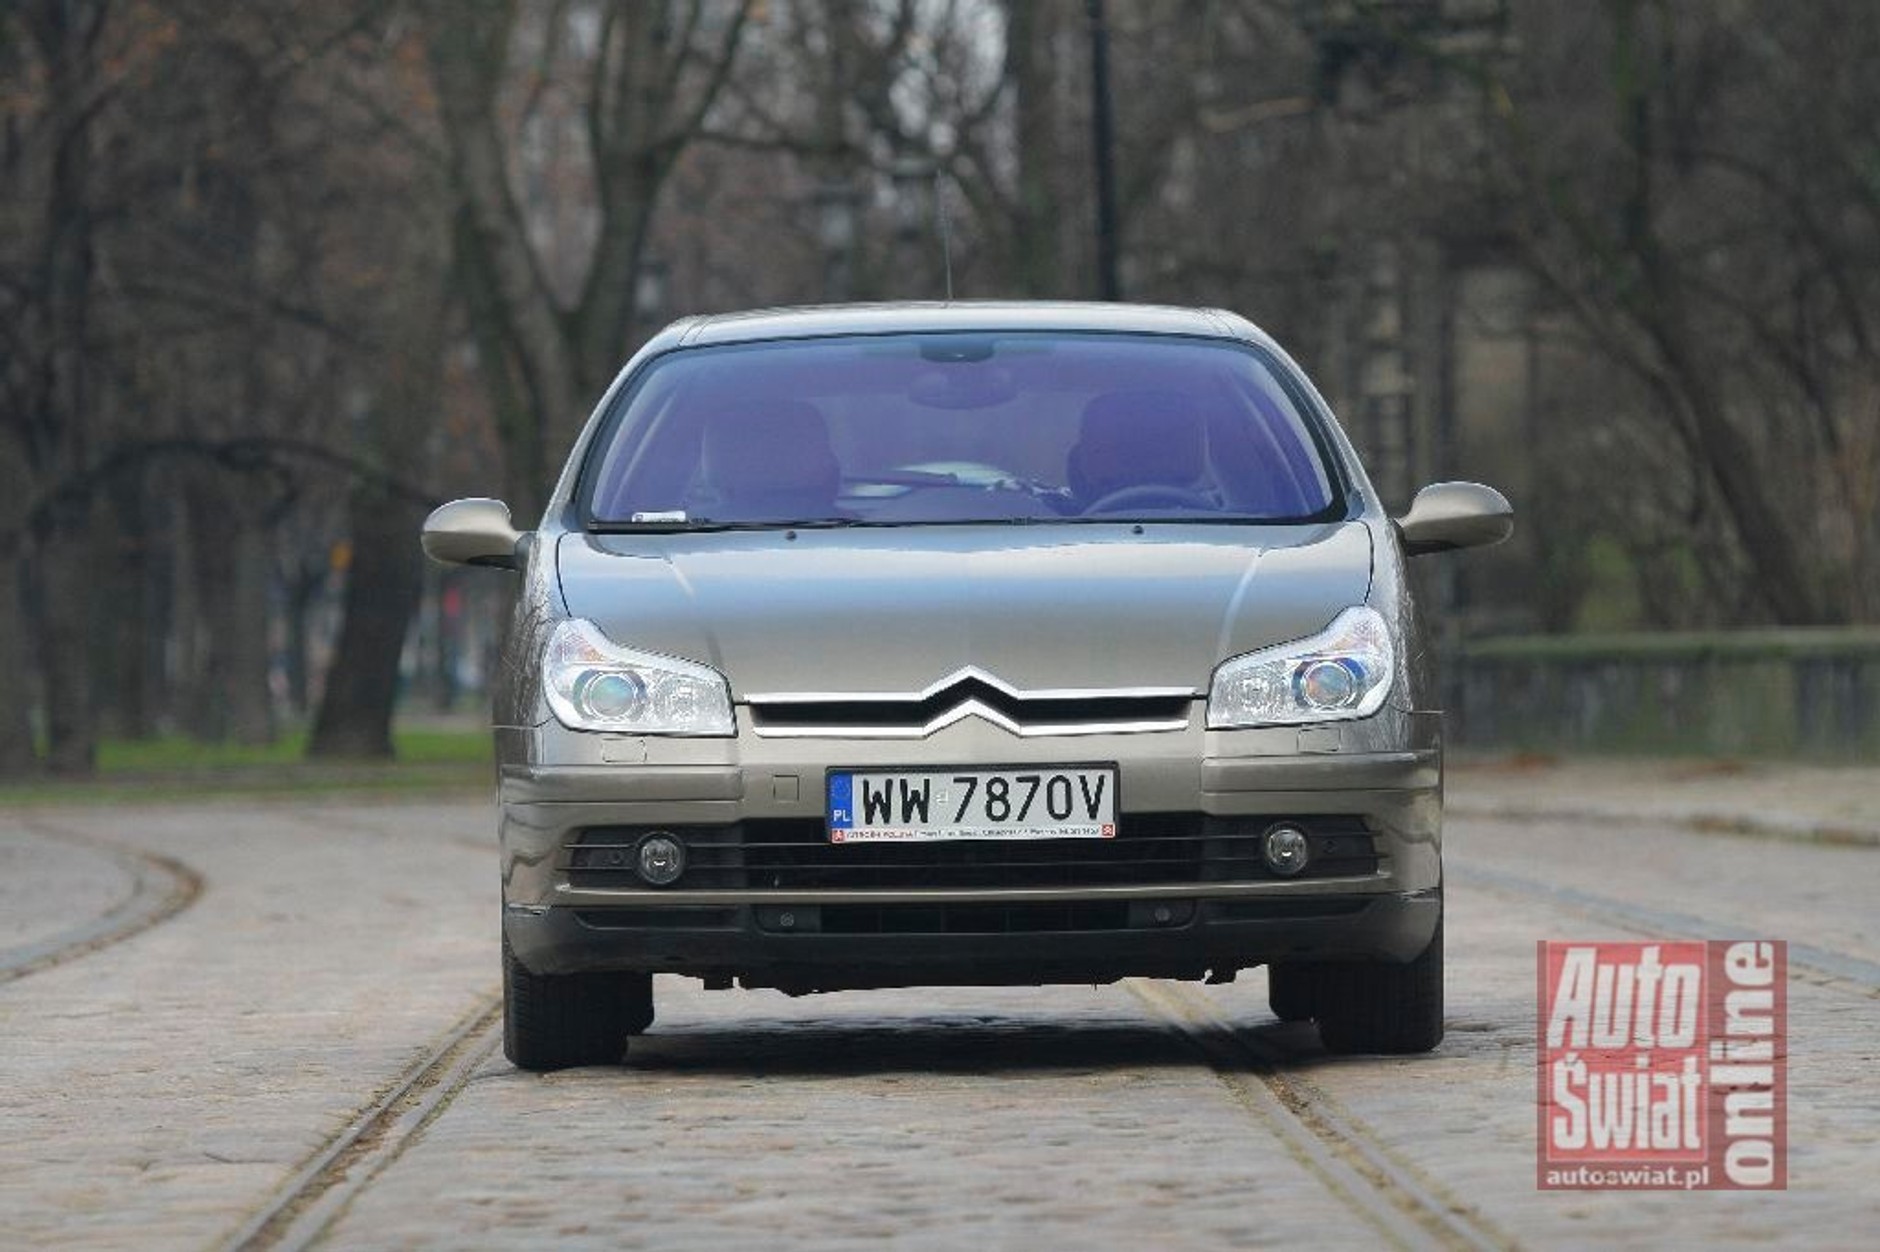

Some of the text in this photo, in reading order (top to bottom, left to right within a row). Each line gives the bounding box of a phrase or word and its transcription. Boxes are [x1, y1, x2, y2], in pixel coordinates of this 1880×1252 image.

[863, 775, 1105, 824] WW 7870V
[834, 810, 851, 822] PL
